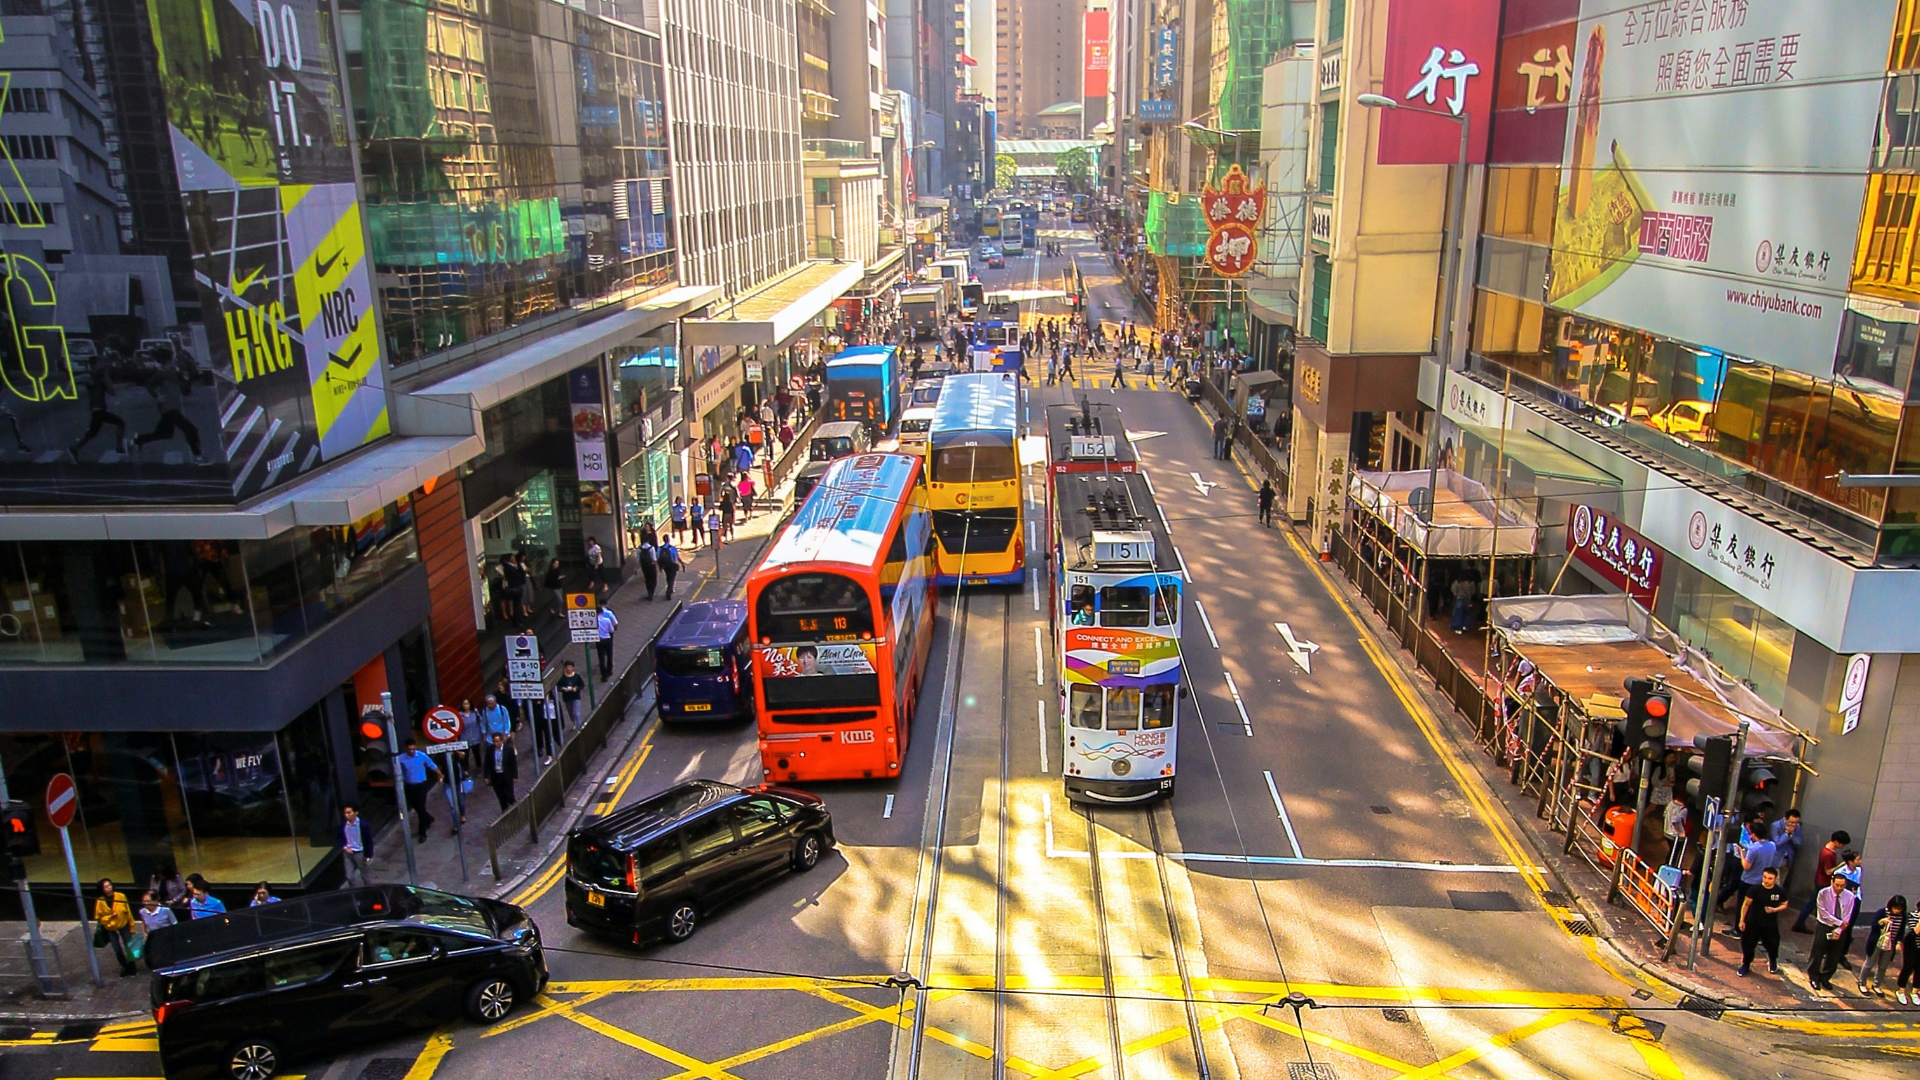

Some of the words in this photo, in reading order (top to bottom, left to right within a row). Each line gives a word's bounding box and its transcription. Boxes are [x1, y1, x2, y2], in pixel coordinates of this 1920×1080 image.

[1622, 0, 1750, 47] 全方位綜合服務
[257, 0, 302, 71] DO
[1160, 30, 1174, 87] 日發文具
[1655, 33, 1802, 93] 照顧您全面需要
[1406, 45, 1482, 117] 行
[269, 79, 312, 147] IT.
[1639, 213, 1713, 263] 工商服務
[1213, 231, 1251, 269] 押
[1773, 243, 1831, 273] 集友銀行
[320, 286, 359, 340] NRC
[1726, 289, 1822, 319] www.chiyubank.com
[225, 300, 294, 383] HKG
[583, 453, 602, 462] MOI
[1081, 443, 1106, 456] 152
[584, 463, 603, 471] MOI
[1111, 543, 1140, 559] 151
[1592, 514, 1654, 578] 集友銀行
[1710, 522, 1776, 580] 集友銀行
[1074, 576, 1089, 584] 151
[1159, 576, 1173, 585] 151
[833, 617, 847, 629] 113
[1076, 634, 1114, 642] CONNECT
[762, 646, 792, 663] No.1
[820, 648, 841, 660] Alan
[773, 661, 799, 676] 英文
[841, 730, 875, 744] KMB
[248, 754, 263, 766] FLY
[1160, 780, 1172, 789] 151
